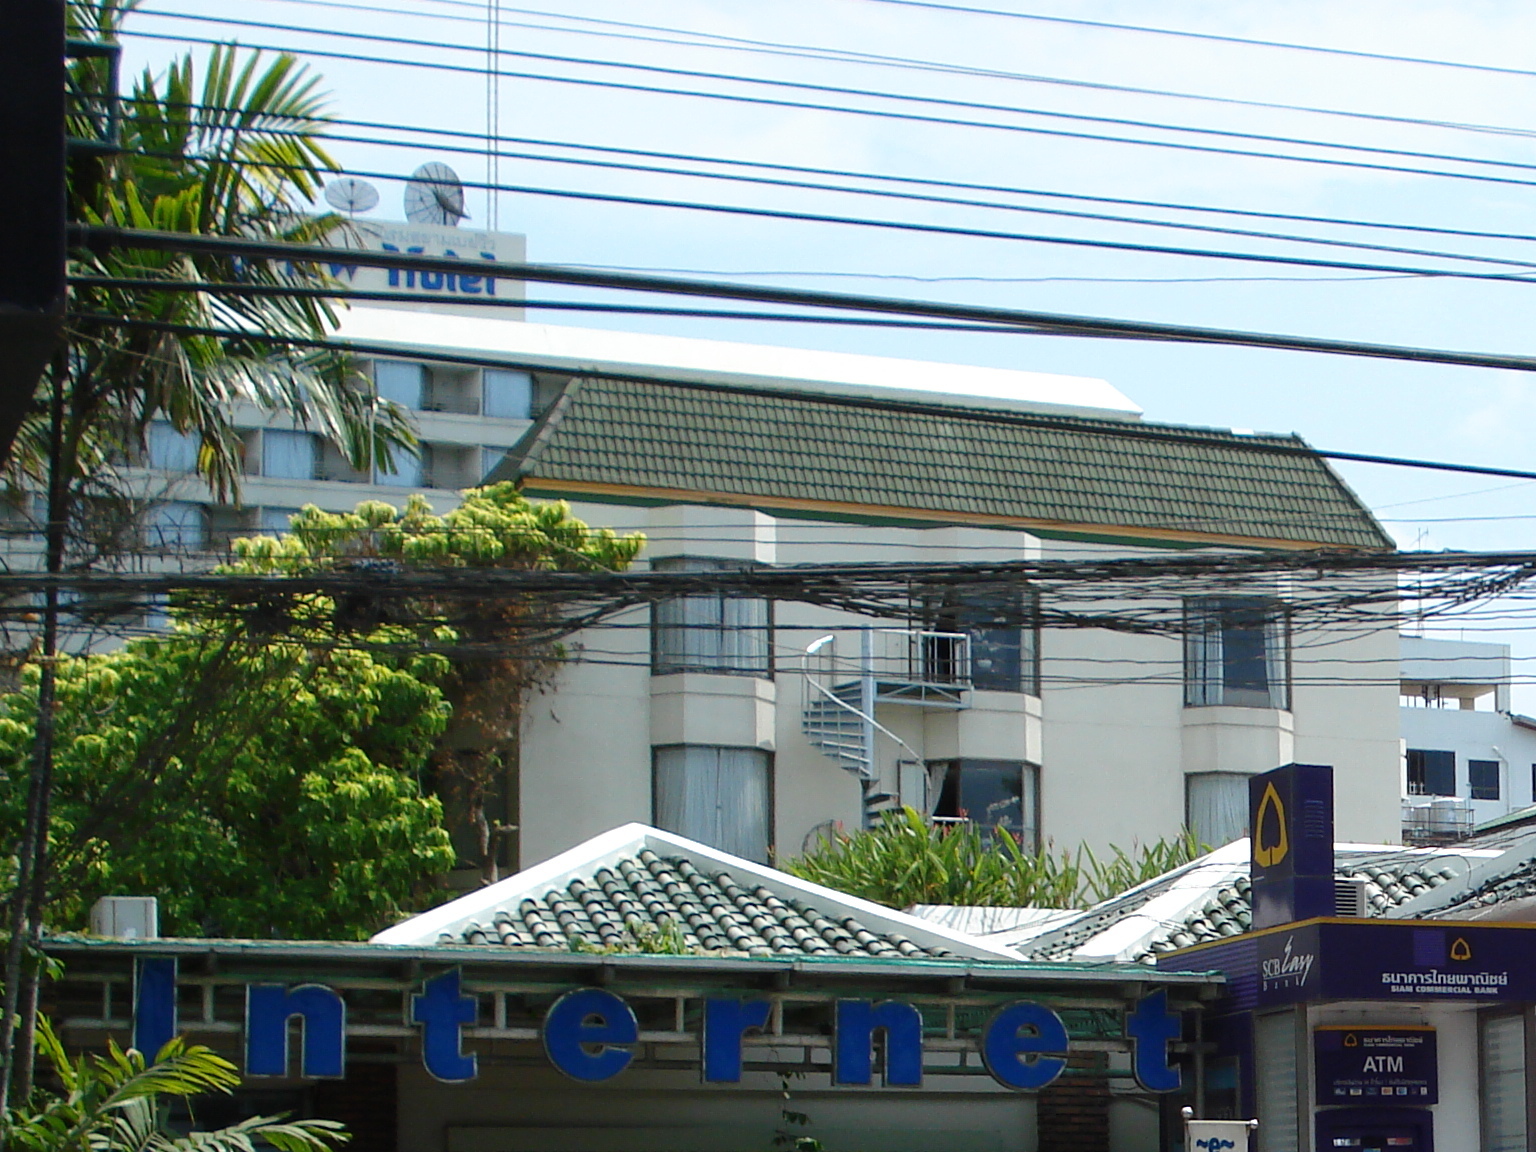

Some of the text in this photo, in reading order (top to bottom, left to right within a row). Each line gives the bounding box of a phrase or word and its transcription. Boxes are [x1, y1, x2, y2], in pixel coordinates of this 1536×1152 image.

[1262, 960, 1280, 979] SCB
[1382, 969, 1508, 986] ธนาคารไทยพาณิชย์
[1391, 985, 1413, 993] SIAM
[1415, 986, 1472, 994] COMMERCIAL
[1363, 1056, 1403, 1072] ATM
